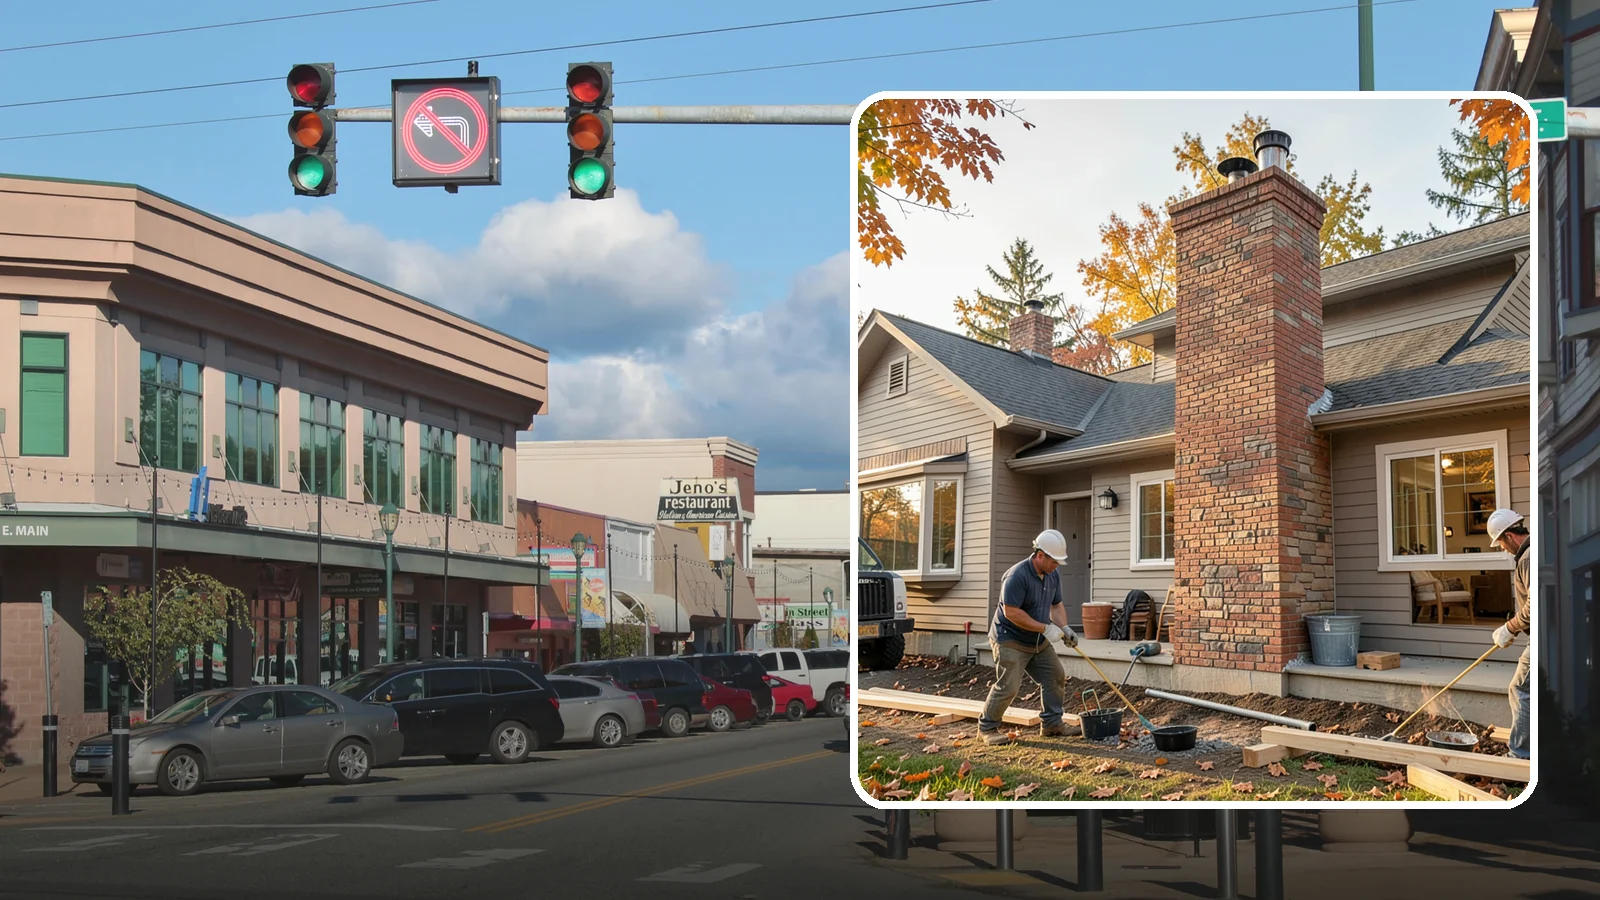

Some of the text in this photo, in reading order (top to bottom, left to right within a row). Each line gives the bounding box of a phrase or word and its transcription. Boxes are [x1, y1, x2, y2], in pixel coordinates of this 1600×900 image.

[669, 480, 727, 494] Jeno's
[665, 496, 731, 509] restaurant
[658, 509, 682, 519] Italian
[685, 509, 715, 519] American
[715, 509, 738, 519] Cuisine
[2, 525, 49, 536] E. MAIN
[797, 607, 828, 617] Street
[791, 619, 824, 627] lass
